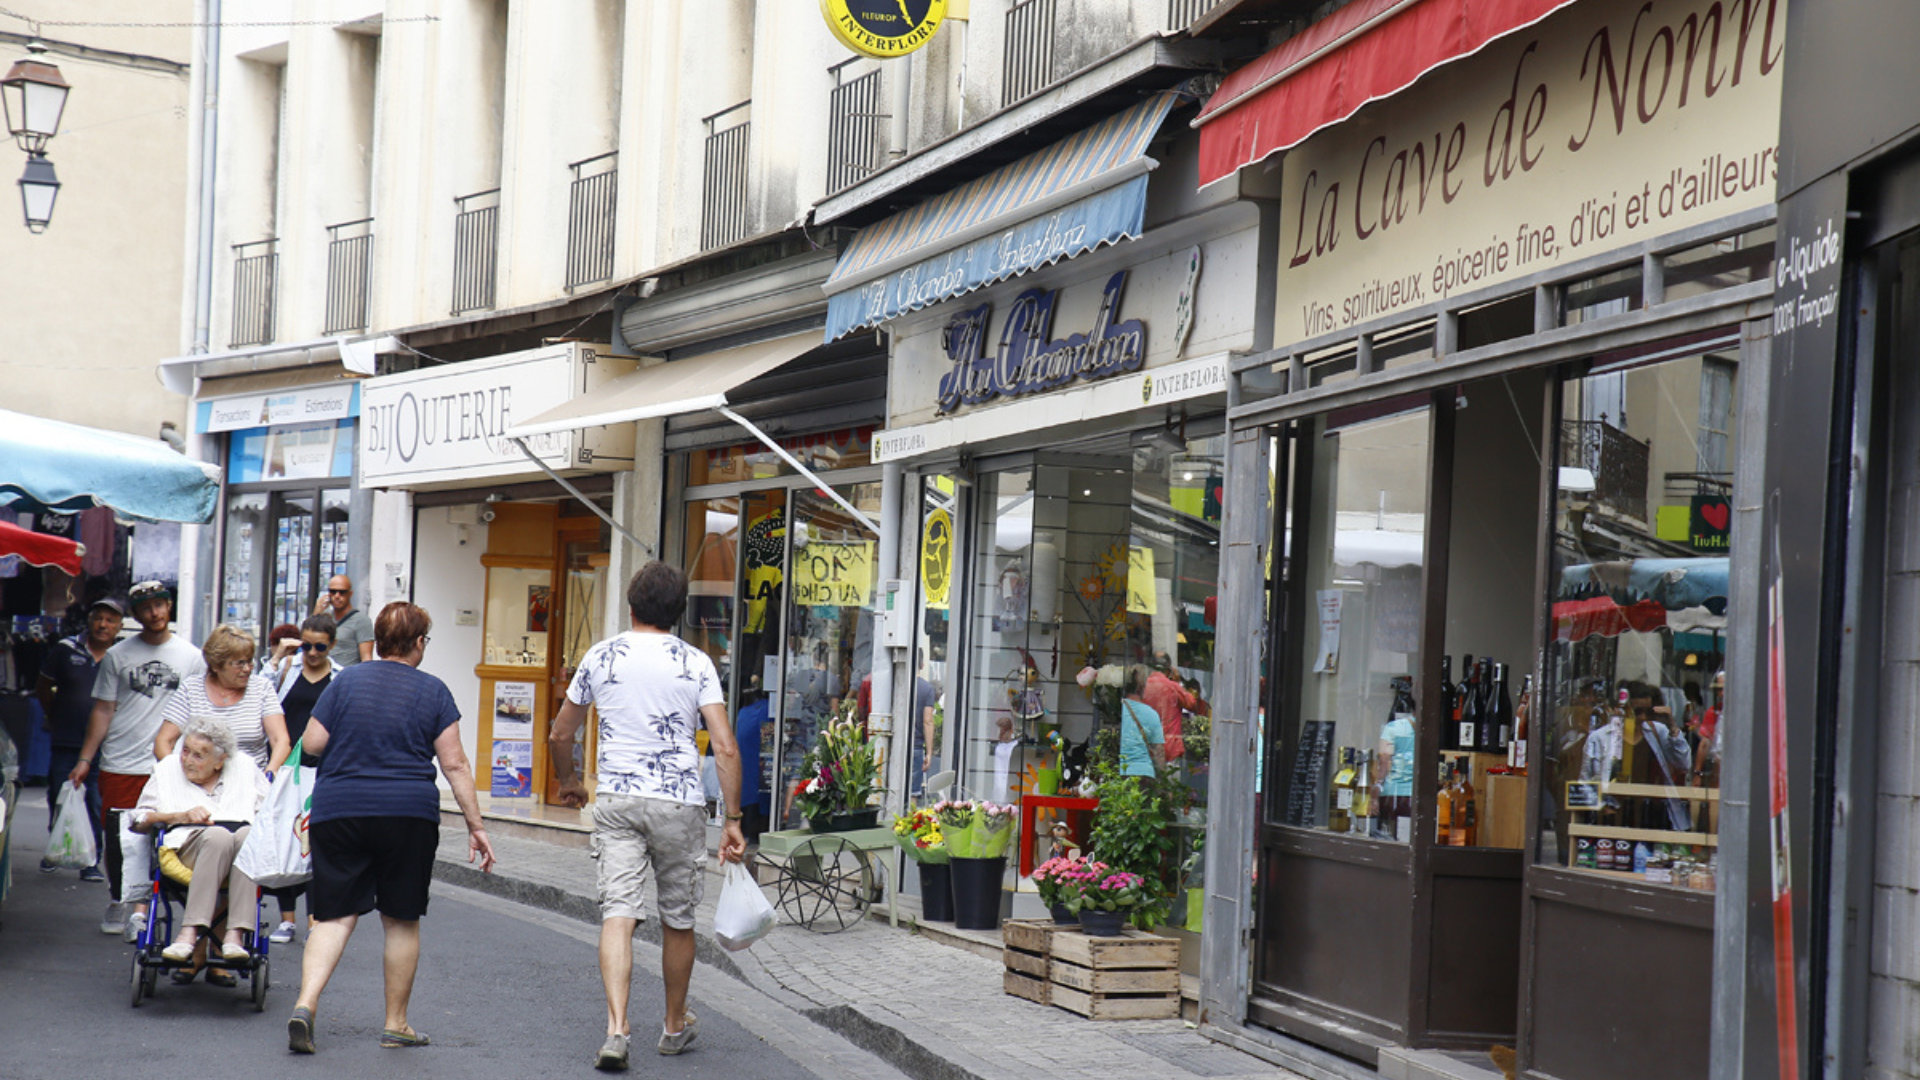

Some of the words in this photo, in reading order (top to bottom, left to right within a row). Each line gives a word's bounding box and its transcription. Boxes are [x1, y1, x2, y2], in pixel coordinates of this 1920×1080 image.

[840, 14, 936, 50] INTERFLORA
[862, 12, 897, 22] FLEUROP
[1289, 169, 1341, 269] La
[1353, 121, 1468, 240] Cave
[1483, 40, 1549, 188] de
[1303, 303, 1337, 337] Vins,
[1342, 271, 1426, 325] spiritueux,
[1432, 235, 1508, 299] épicerie
[1516, 222, 1563, 268] fine,
[1570, 192, 1617, 247] d'ici
[1625, 181, 1651, 229] et
[1777, 218, 1839, 290] e-liquide
[996, 270, 1145, 397] Chardon
[305, 397, 343, 413] Estimations
[1155, 364, 1227, 397] INTERFLORA
[368, 386, 511, 464] BIJOUTERIE
[882, 434, 925, 454] INTERFLORA
